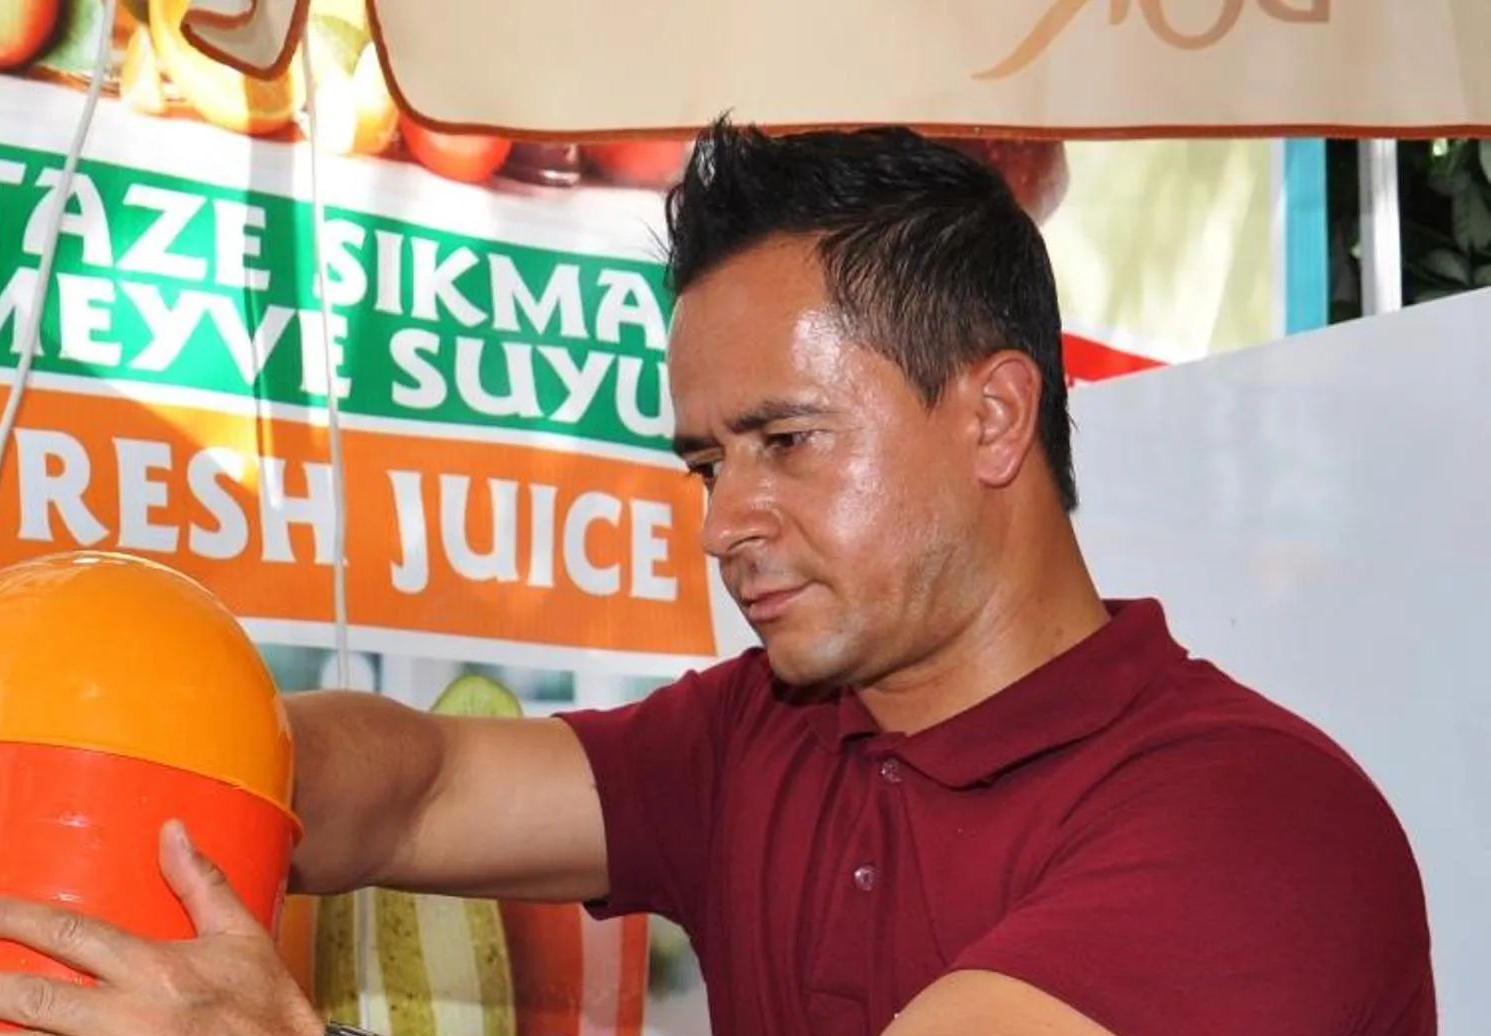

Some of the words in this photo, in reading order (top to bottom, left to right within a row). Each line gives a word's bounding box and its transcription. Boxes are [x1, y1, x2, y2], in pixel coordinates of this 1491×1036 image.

[312, 218, 667, 350] SIKMA
[387, 329, 676, 441] SUYU
[386, 469, 678, 601] JUICE
